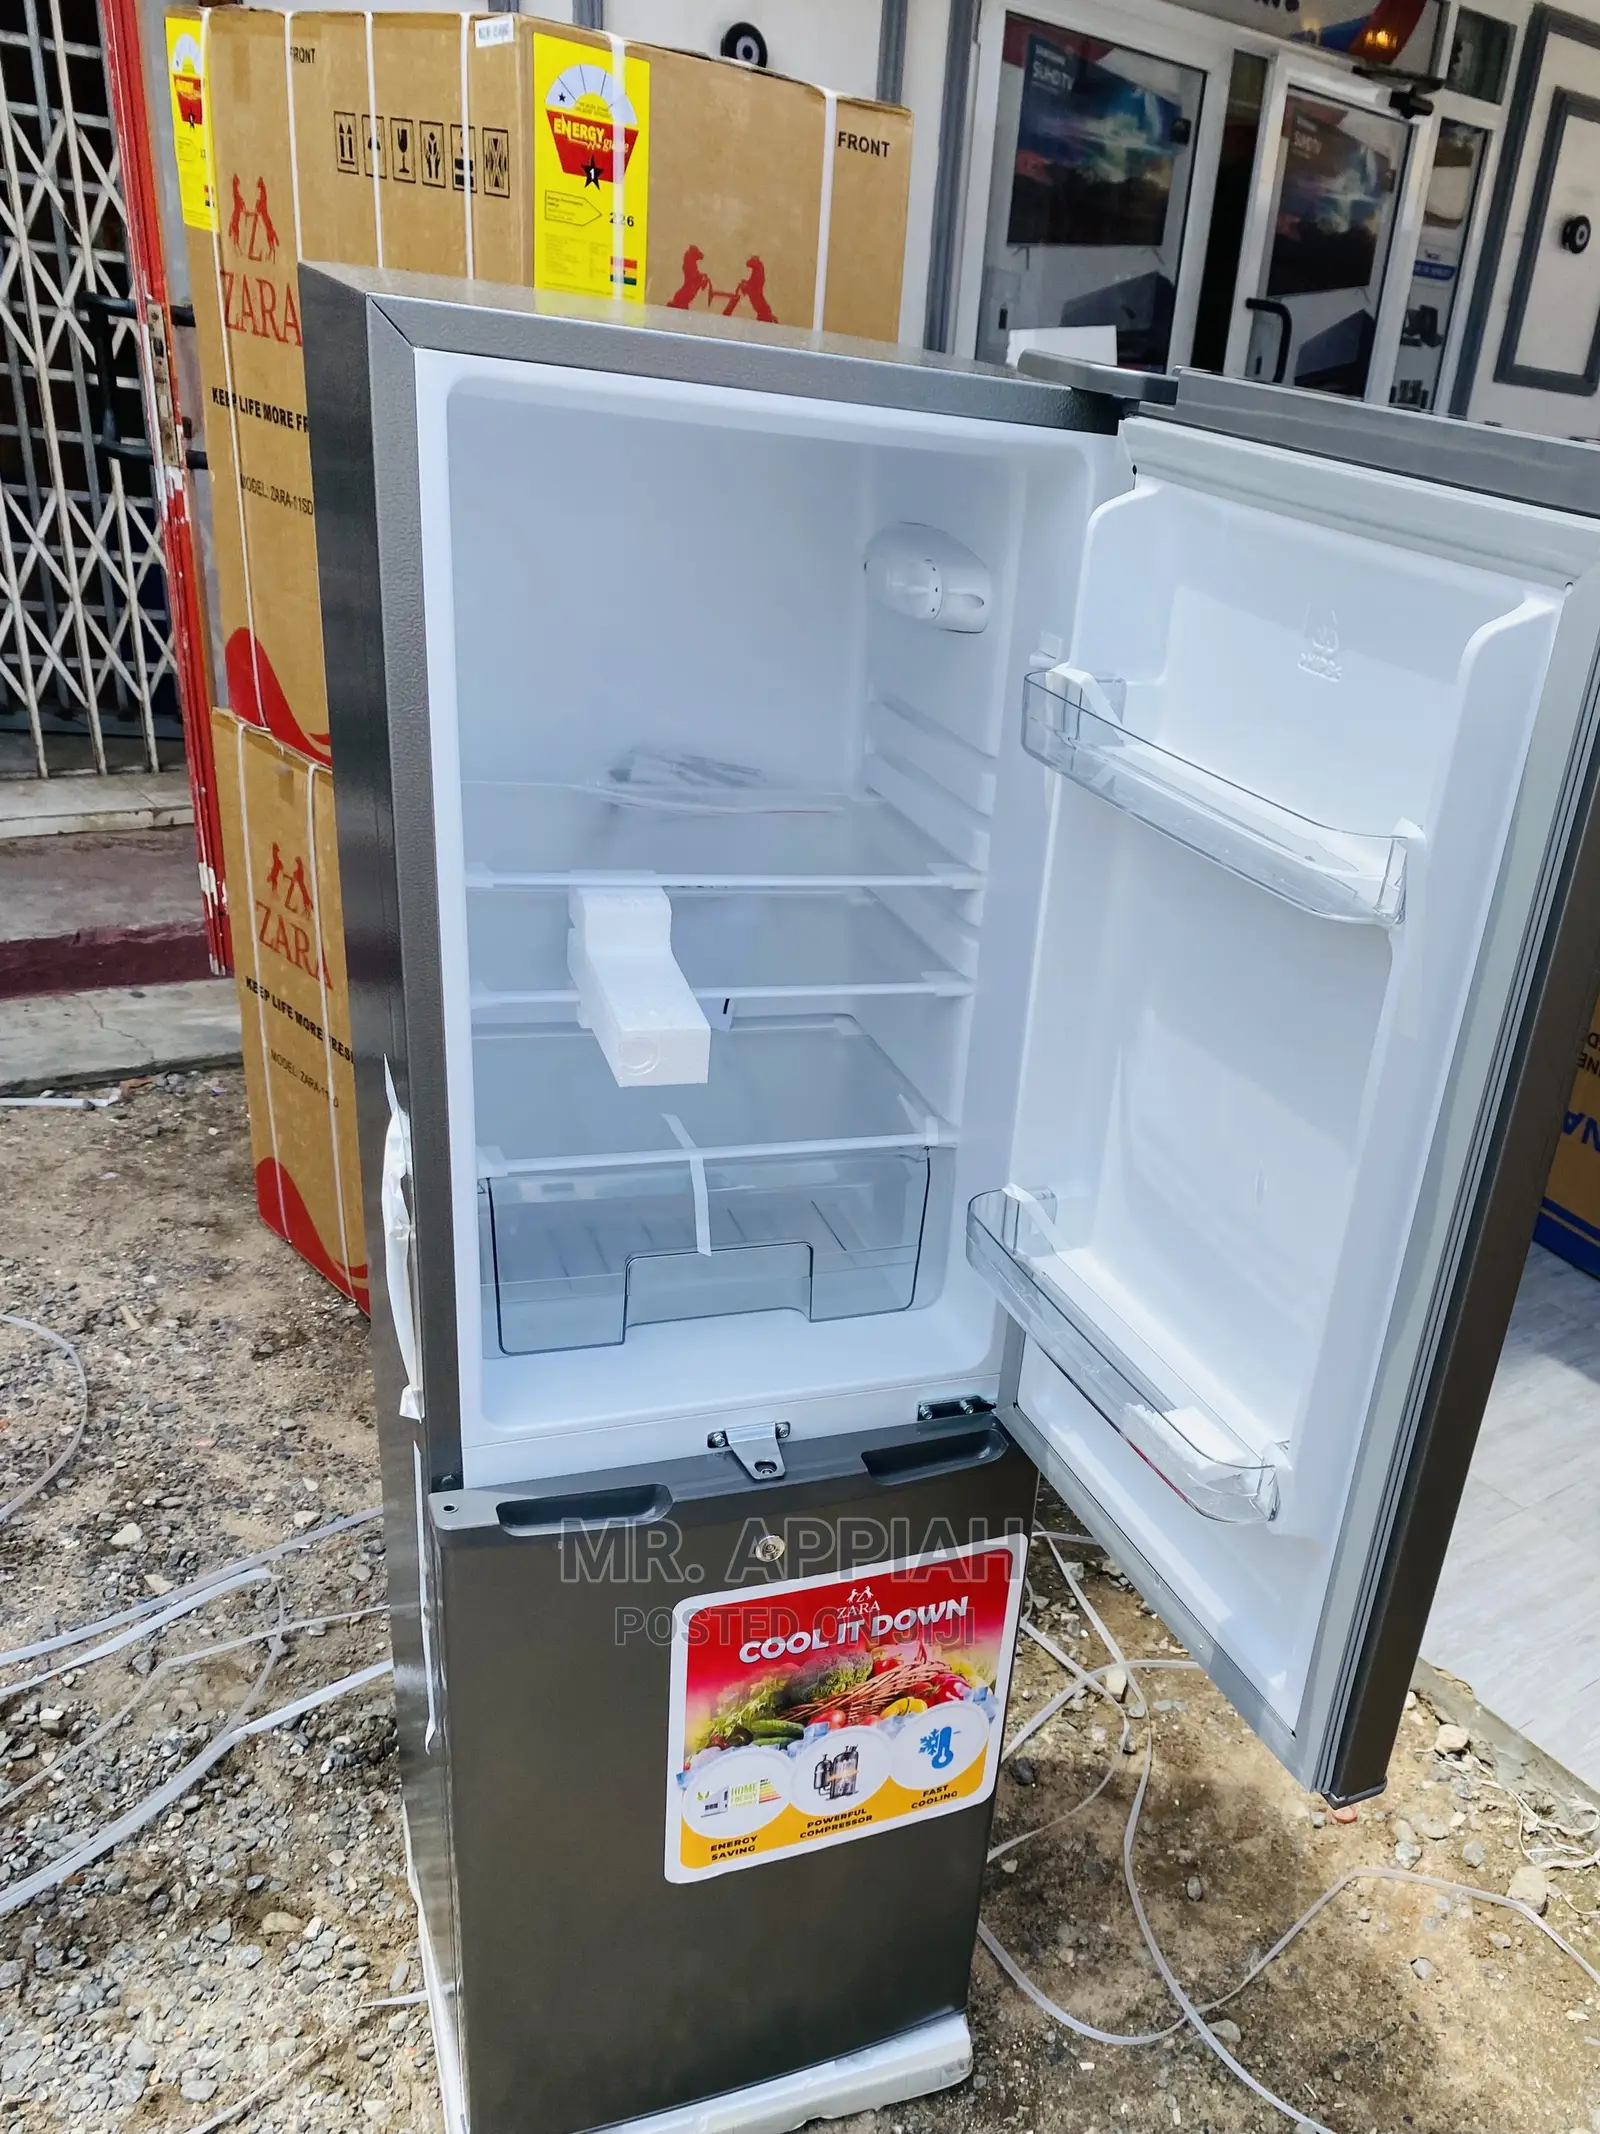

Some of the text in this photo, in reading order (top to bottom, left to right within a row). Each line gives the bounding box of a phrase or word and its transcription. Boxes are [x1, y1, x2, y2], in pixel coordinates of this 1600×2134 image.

[553, 113, 605, 143] ENERGY
[602, 138, 630, 153] gue
[837, 130, 891, 158] FRONT
[219, 269, 303, 348] ZARA
[238, 395, 262, 419] LIFE
[263, 403, 295, 429] MORE
[256, 899, 334, 990] ZARA
[245, 976, 354, 1065] KEEP LIFE MORE RES
[299, 1070, 339, 1108] ZARA-11D
[836, 1600, 881, 1620] ZARA
[738, 1595, 969, 1664] COOL IT DOWN
[910, 1790, 958, 1810] COOLING
[922, 1784, 949, 1798] FAST
[799, 1814, 873, 1839] COMPRESSOR
[806, 1808, 867, 1828] POWERFUL
[710, 1835, 758, 1852] ENERGY
[711, 1845, 756, 1861] SAVING
